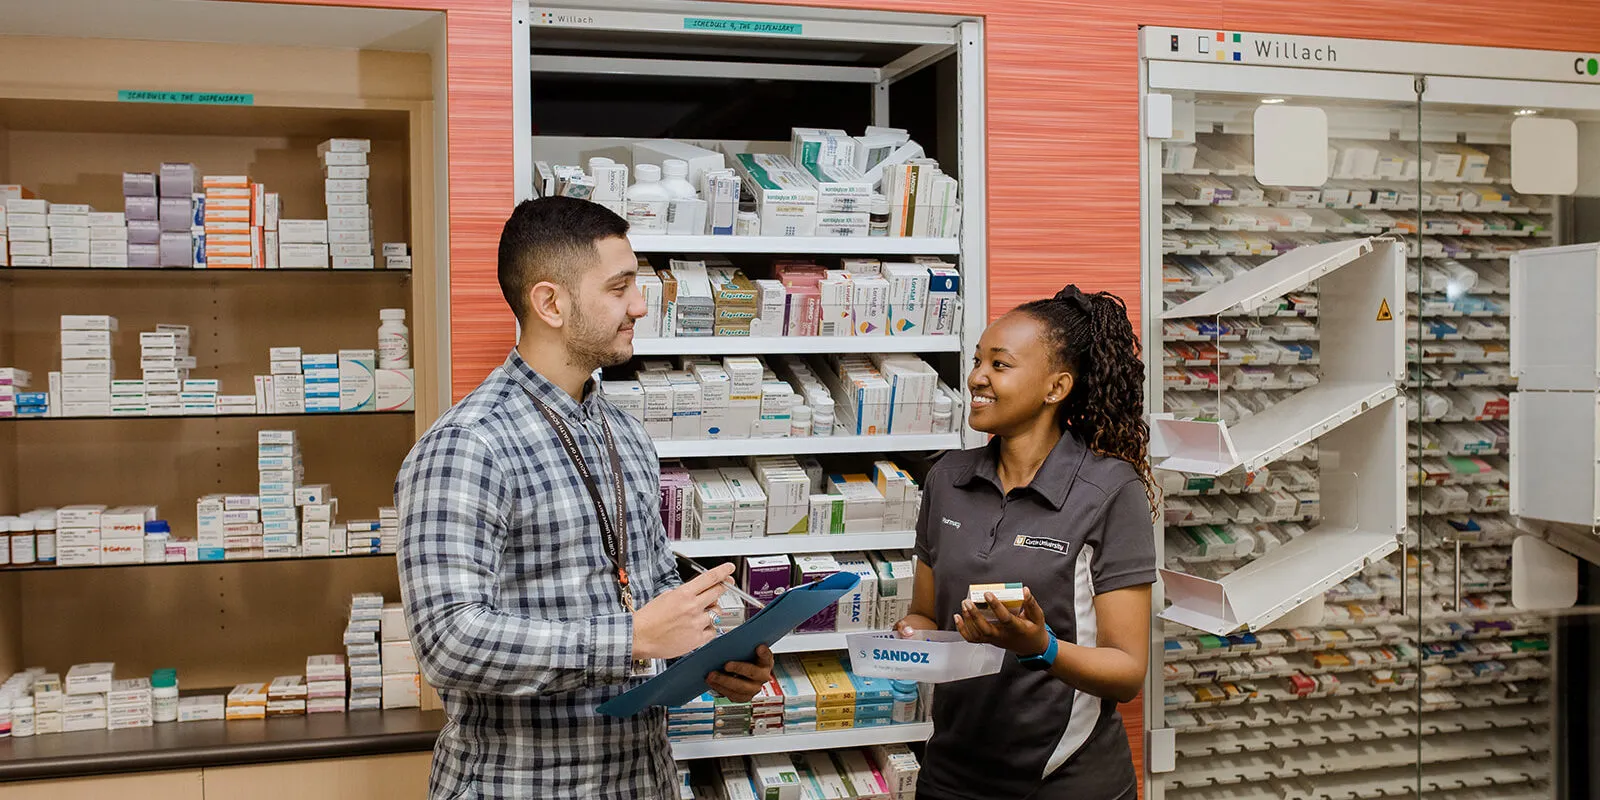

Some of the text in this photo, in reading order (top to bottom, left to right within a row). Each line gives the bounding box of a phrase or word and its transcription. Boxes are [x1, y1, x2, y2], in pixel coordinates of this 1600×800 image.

[558, 15, 594, 24] Willach
[693, 20, 726, 28] SCHEDULE
[754, 24, 795, 32] DISPENSARY
[1255, 40, 1336, 61] Willach
[128, 91, 166, 100] SCHEDULE
[199, 95, 245, 103] DISPENSARY
[721, 291, 754, 299] Lipitor
[871, 287, 879, 308] Lorstat
[908, 277, 919, 311] Lorstat 80
[559, 425, 573, 447] HEALTH
[575, 455, 589, 478] FACULTY
[597, 500, 617, 557] CURTIN UNIVERSITY
[851, 593, 861, 623] NIZAC
[872, 648, 930, 664] SANDOZ
